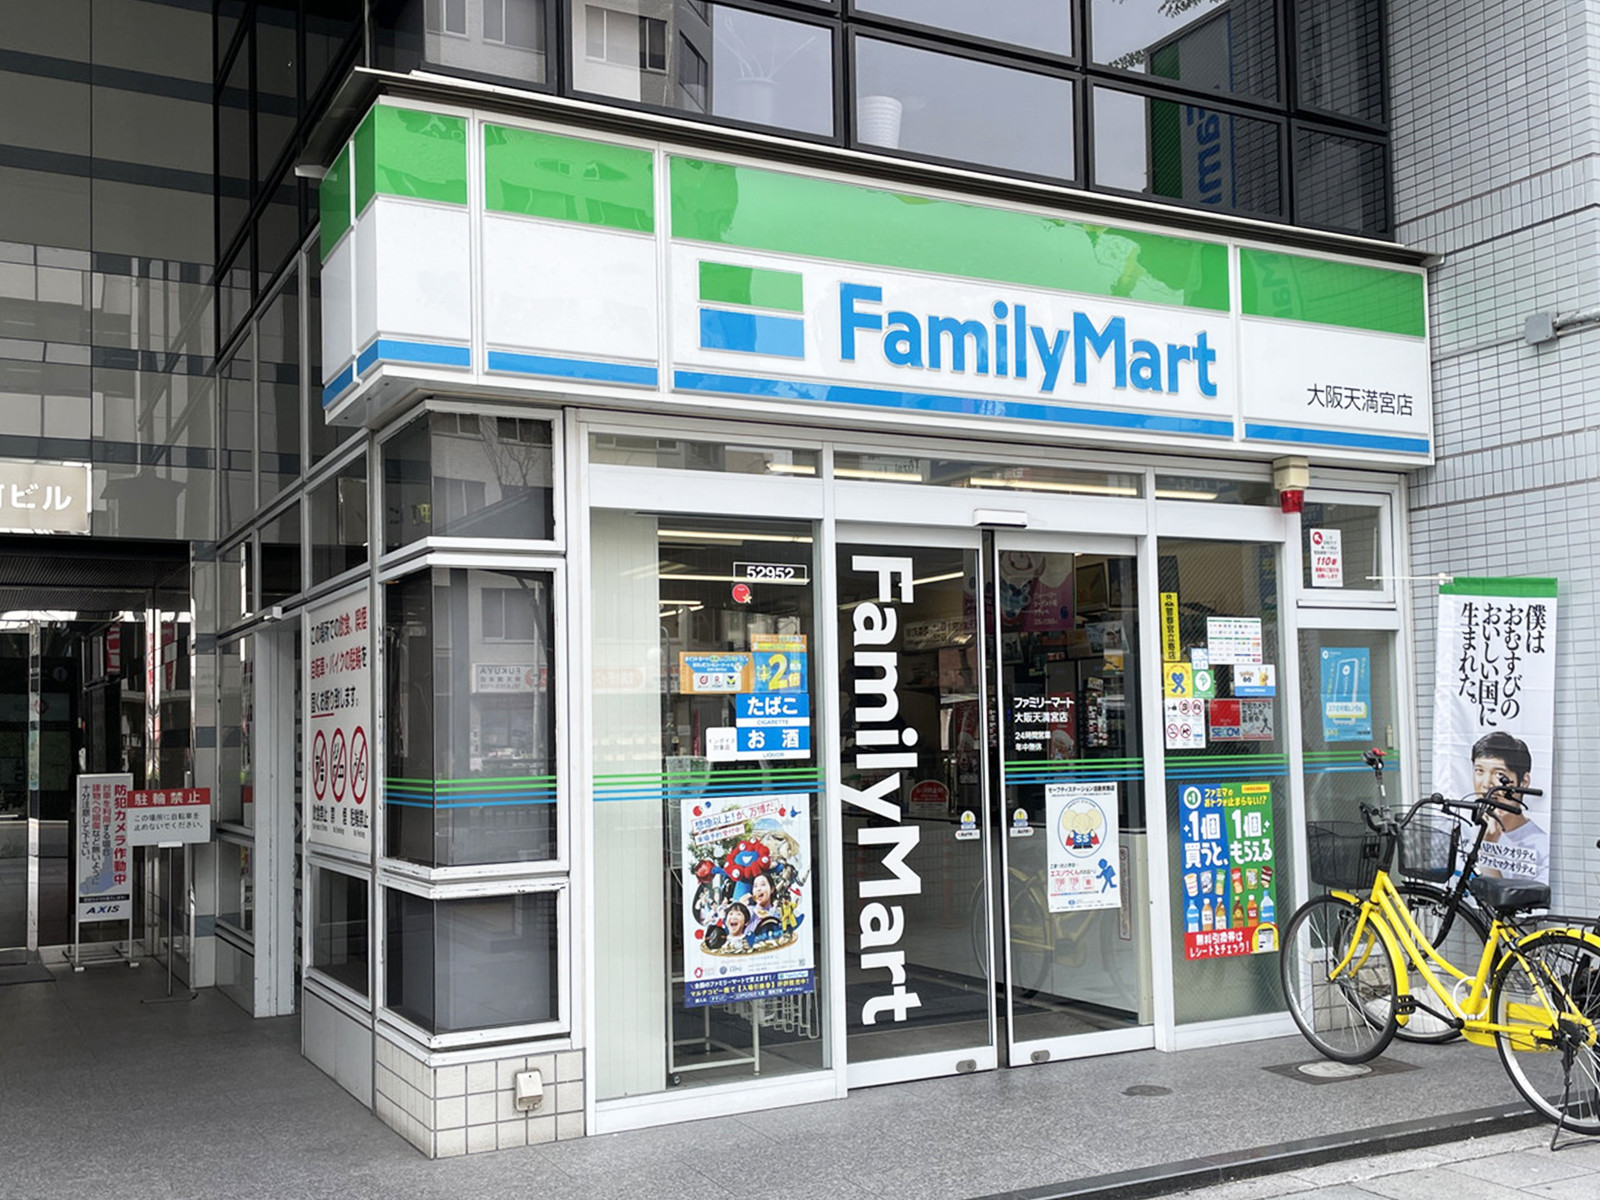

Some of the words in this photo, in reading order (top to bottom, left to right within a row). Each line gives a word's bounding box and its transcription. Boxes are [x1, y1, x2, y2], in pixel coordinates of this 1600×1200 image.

[838, 281, 1217, 398] FamilyMart
[1306, 383, 1413, 417] 大阪天満宮店
[0, 483, 72, 512] ビル
[746, 566, 795, 580] 52952
[1525, 604, 1547, 654] 僕は
[1457, 602, 1480, 704] 生まれた。
[1500, 604, 1523, 720] おむすびの
[1478, 602, 1502, 727] おいしい国に
[747, 696, 799, 715] たばこ
[1013, 696, 1075, 709] ファミリーマート
[1014, 711, 1069, 723] 大阪天満宮店
[747, 729, 800, 748] お酒
[1014, 731, 1052, 740] 24時間営業
[1211, 727, 1240, 737] SECOM
[1015, 743, 1043, 752] 年中無休
[134, 791, 201, 806] 駐輪禁止
[840, 555, 922, 1026] FamilyMart
[1204, 787, 1234, 797] ファミマの
[133, 812, 200, 823] この場所に自転車を
[133, 821, 204, 832] 止めないでください。
[1188, 810, 1221, 842] 1個
[1231, 809, 1262, 839] 1個
[114, 784, 128, 885] 防犯カメラ作動中
[1075, 835, 1090, 843] SS
[1184, 841, 1229, 869] 買うと、
[1229, 838, 1273, 865] もらえる
[85, 905, 120, 915] AXIS
[1195, 931, 1243, 945] 無料引換券は
[1189, 940, 1250, 959] レシートをチェック!
